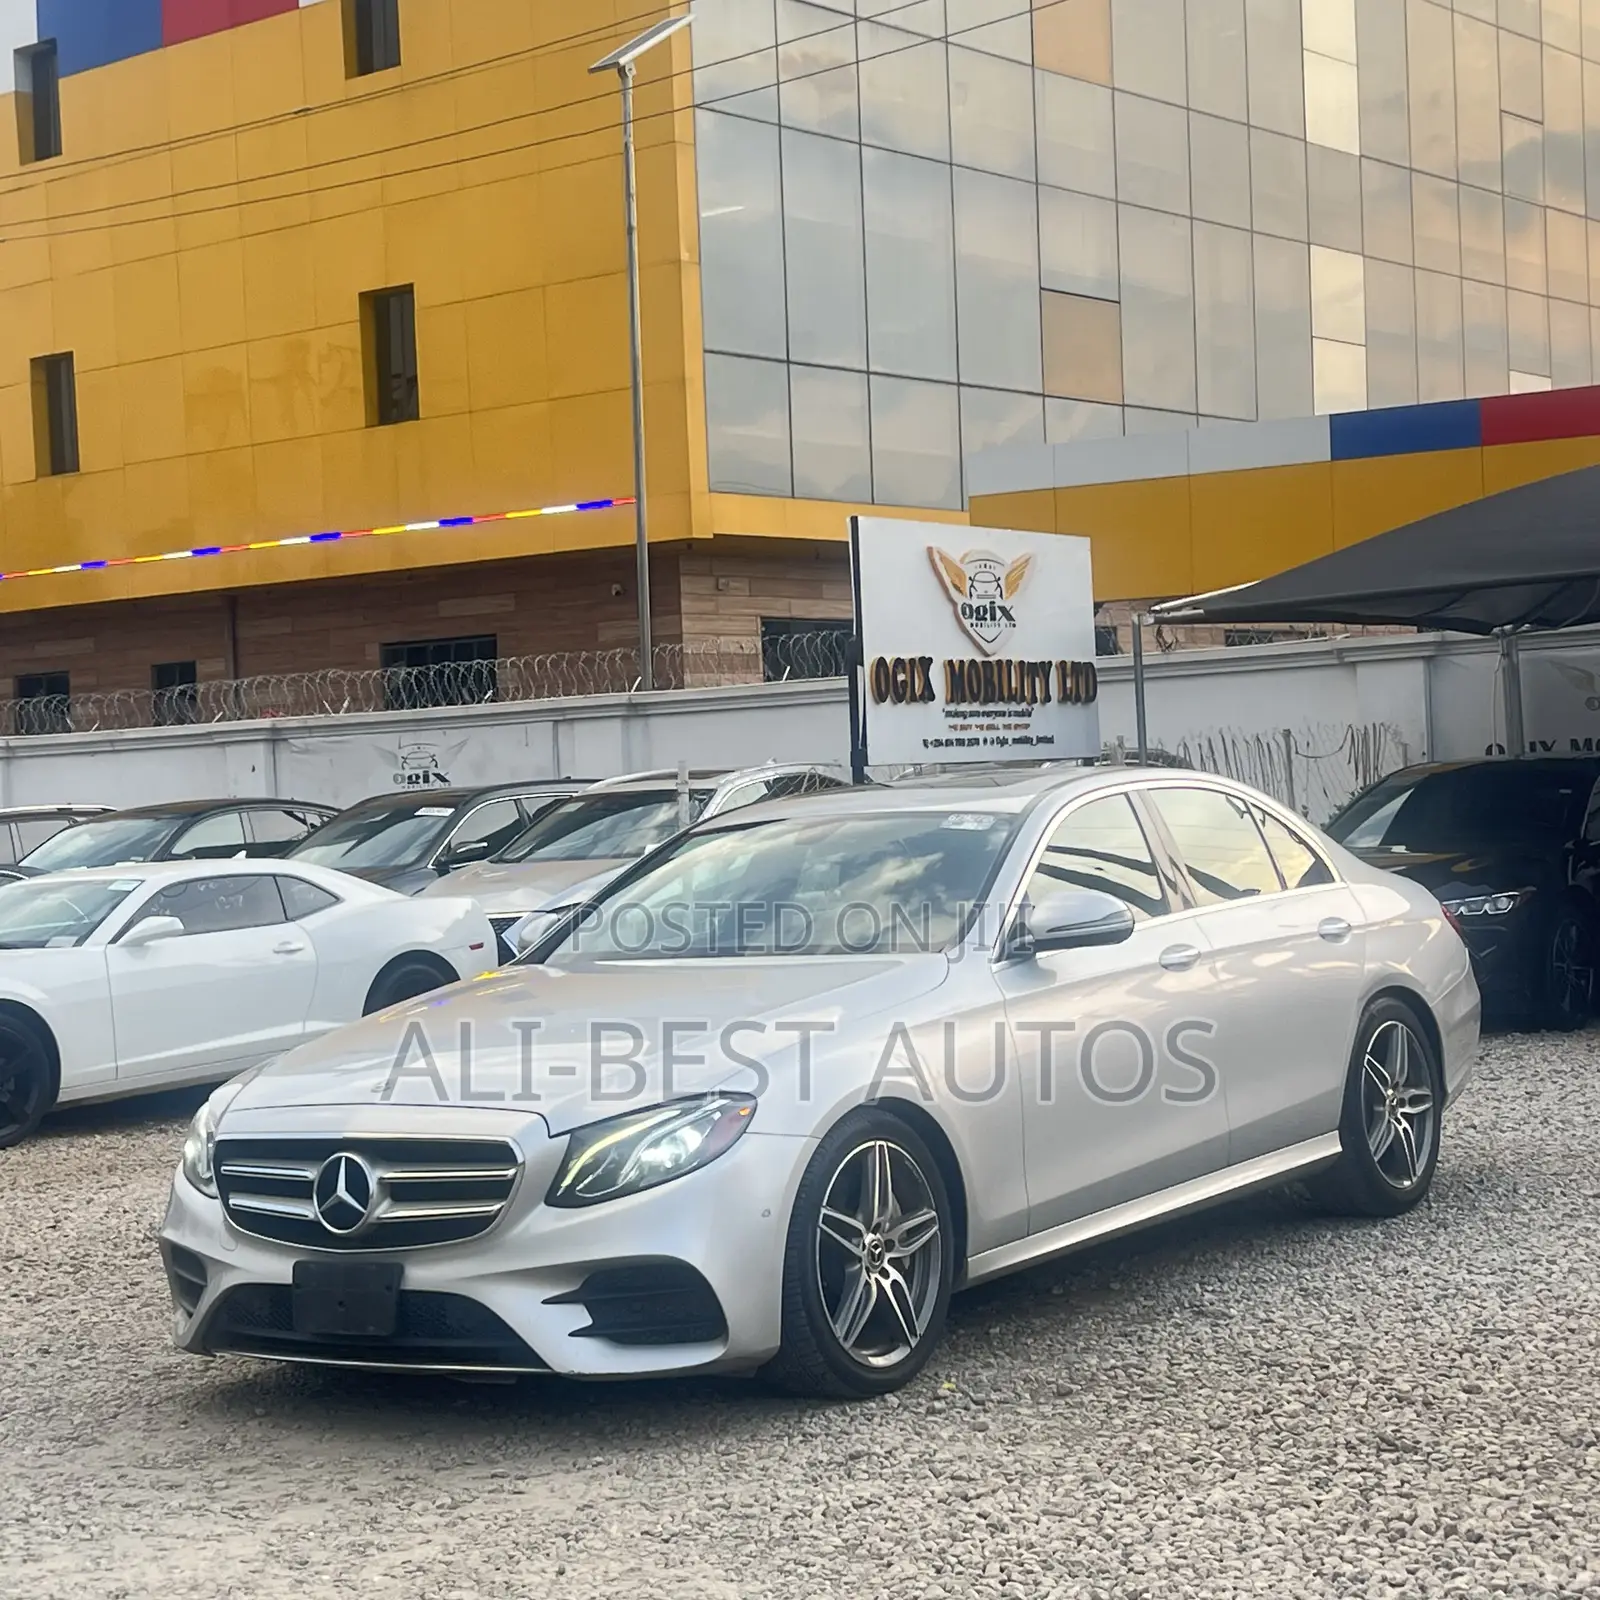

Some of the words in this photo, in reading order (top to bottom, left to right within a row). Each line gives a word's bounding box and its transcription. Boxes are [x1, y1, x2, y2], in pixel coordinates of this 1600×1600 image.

[870, 656, 937, 705] OGIX
[943, 657, 1053, 706] MOBILITY
[1055, 659, 1098, 705] LTD
